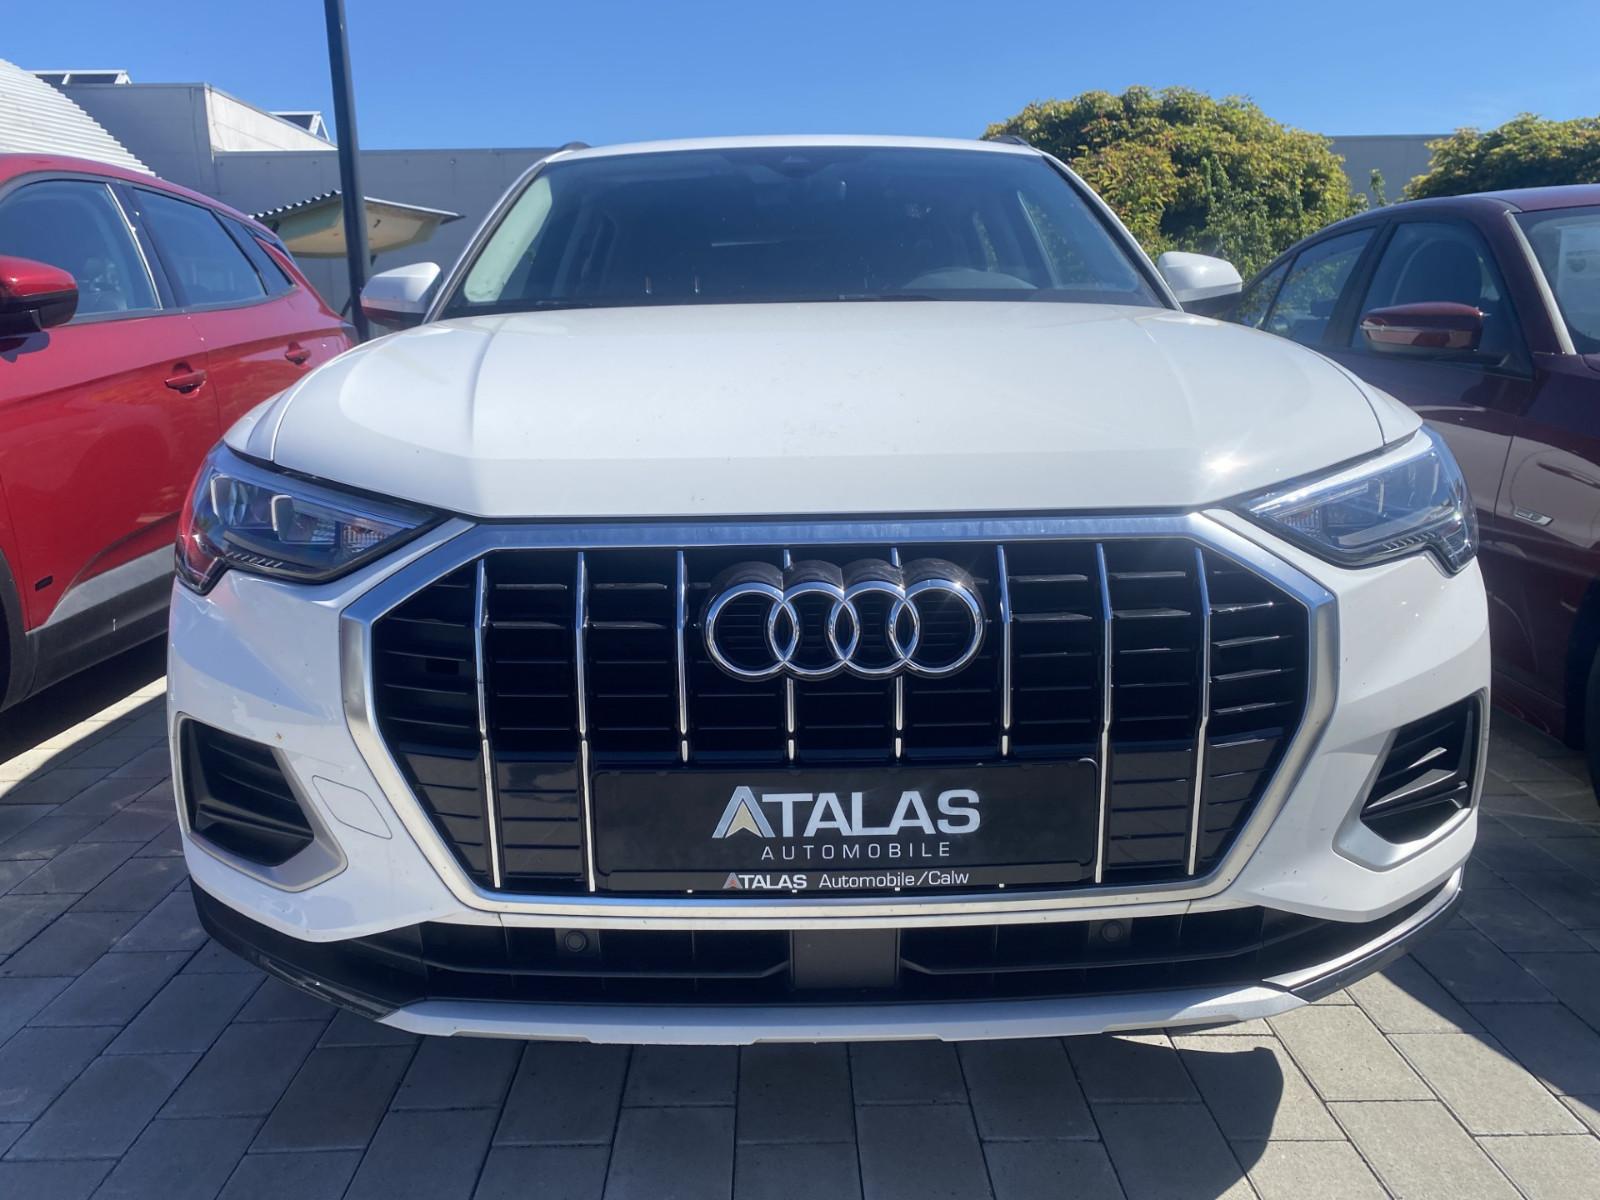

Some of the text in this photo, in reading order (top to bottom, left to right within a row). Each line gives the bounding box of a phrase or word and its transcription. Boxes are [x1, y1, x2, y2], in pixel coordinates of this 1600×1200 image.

[711, 785, 981, 839] ATALAS
[760, 842, 951, 861] AUTOMOBILE
[722, 870, 969, 889] ATALAS Automobile/Calw
